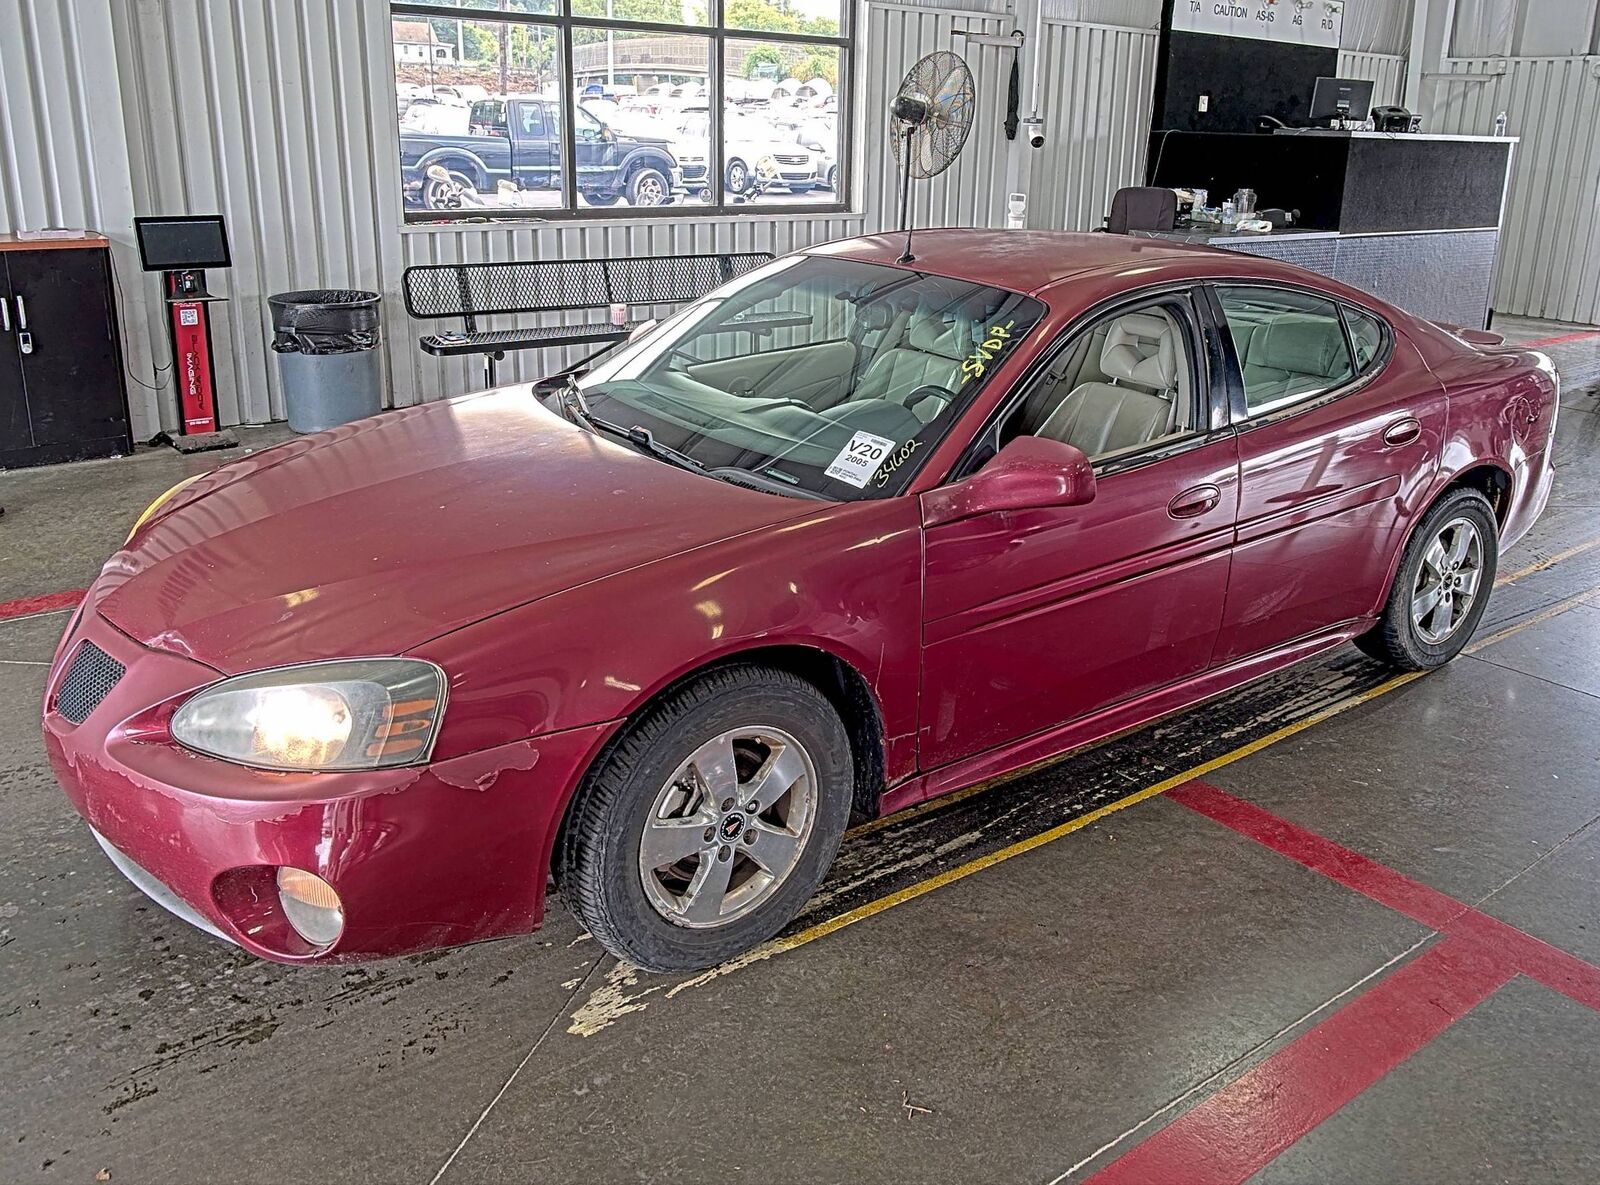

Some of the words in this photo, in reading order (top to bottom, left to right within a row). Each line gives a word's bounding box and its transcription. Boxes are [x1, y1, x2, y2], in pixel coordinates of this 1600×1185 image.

[1190, 1, 1201, 13] T/A
[1213, 3, 1248, 18] CAUTION
[1255, 10, 1275, 22] AS-IS
[1292, 15, 1303, 26] AG
[186, 352, 197, 395] IMAGING
[845, 454, 869, 467] 2005
[849, 440, 883, 460] V20
